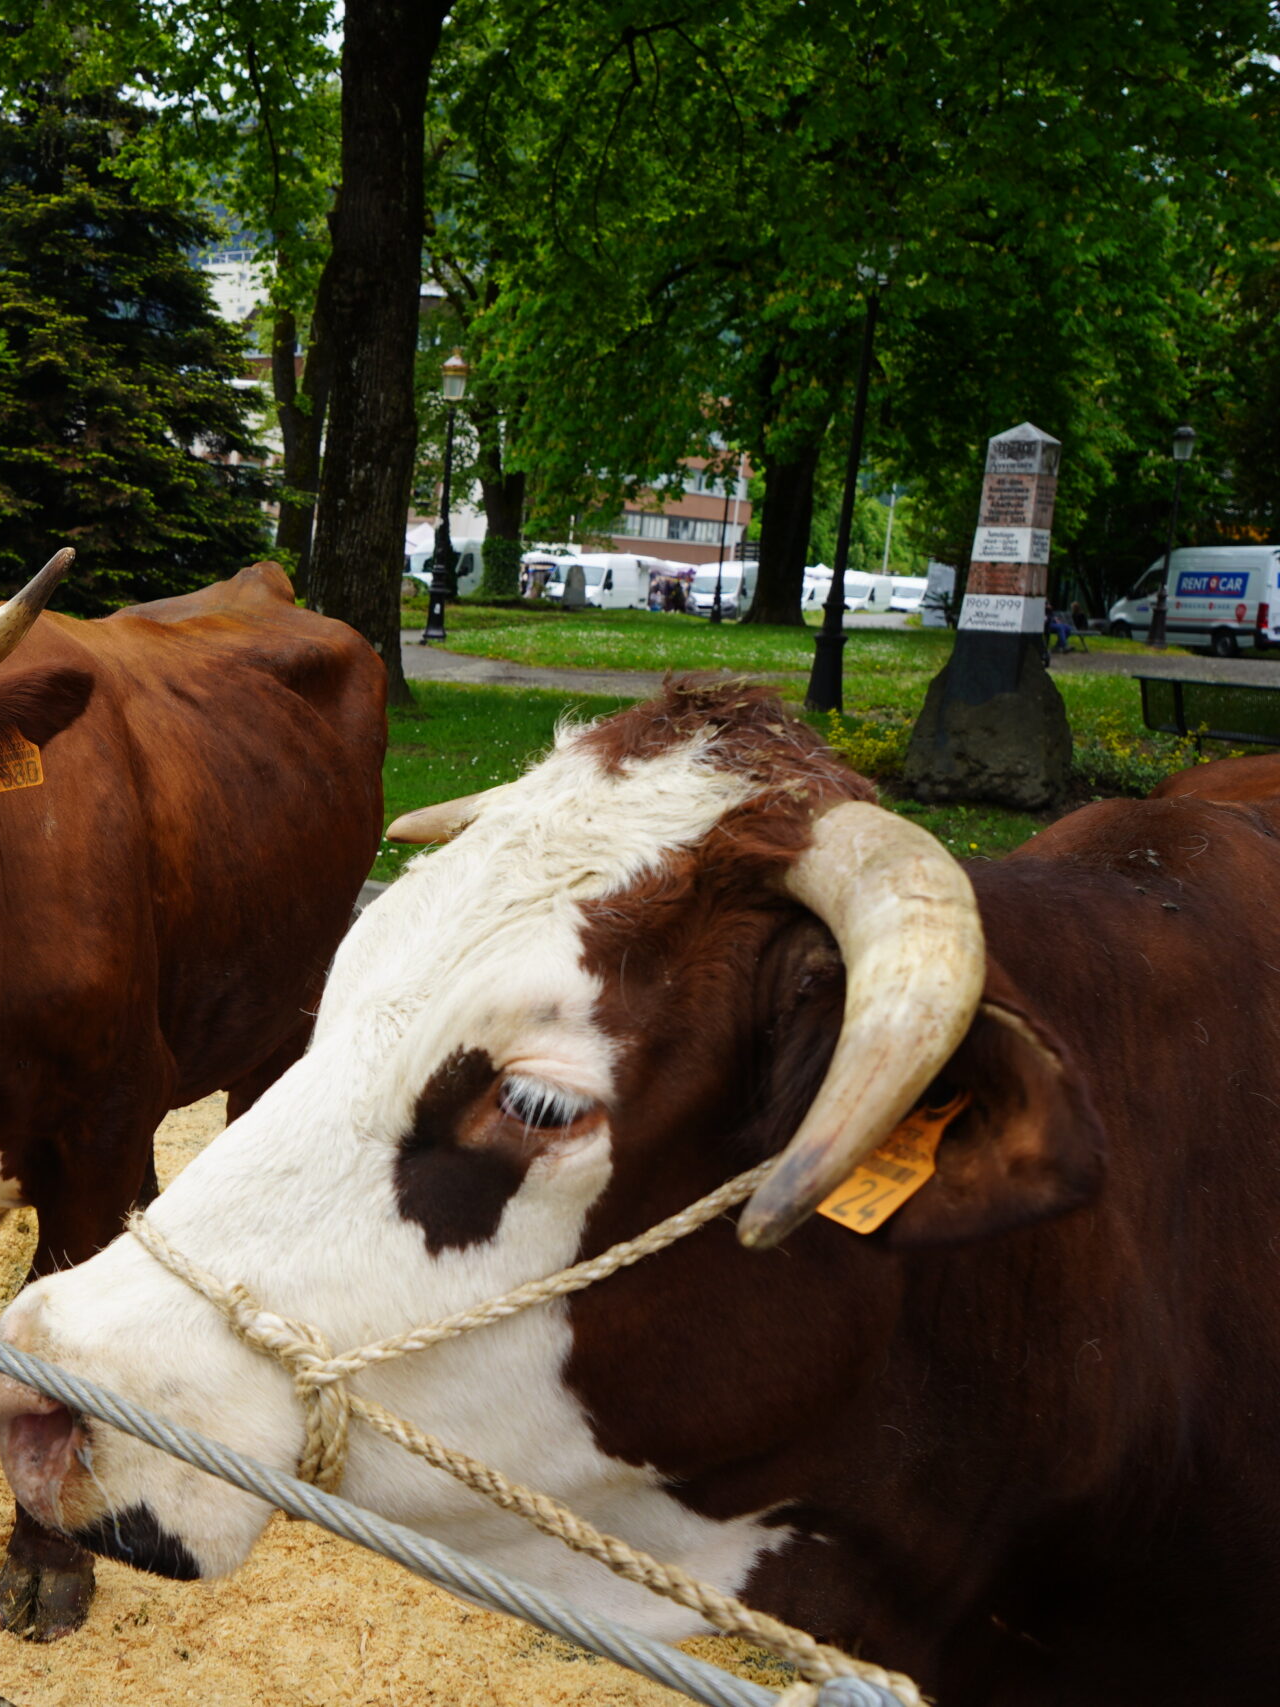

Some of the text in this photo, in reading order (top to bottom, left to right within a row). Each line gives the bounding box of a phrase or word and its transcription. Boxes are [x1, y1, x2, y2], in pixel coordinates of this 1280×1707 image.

[1180, 577, 1208, 591] RENT
[1218, 577, 1244, 592] CAR
[966, 597, 1022, 610] 1969 1999
